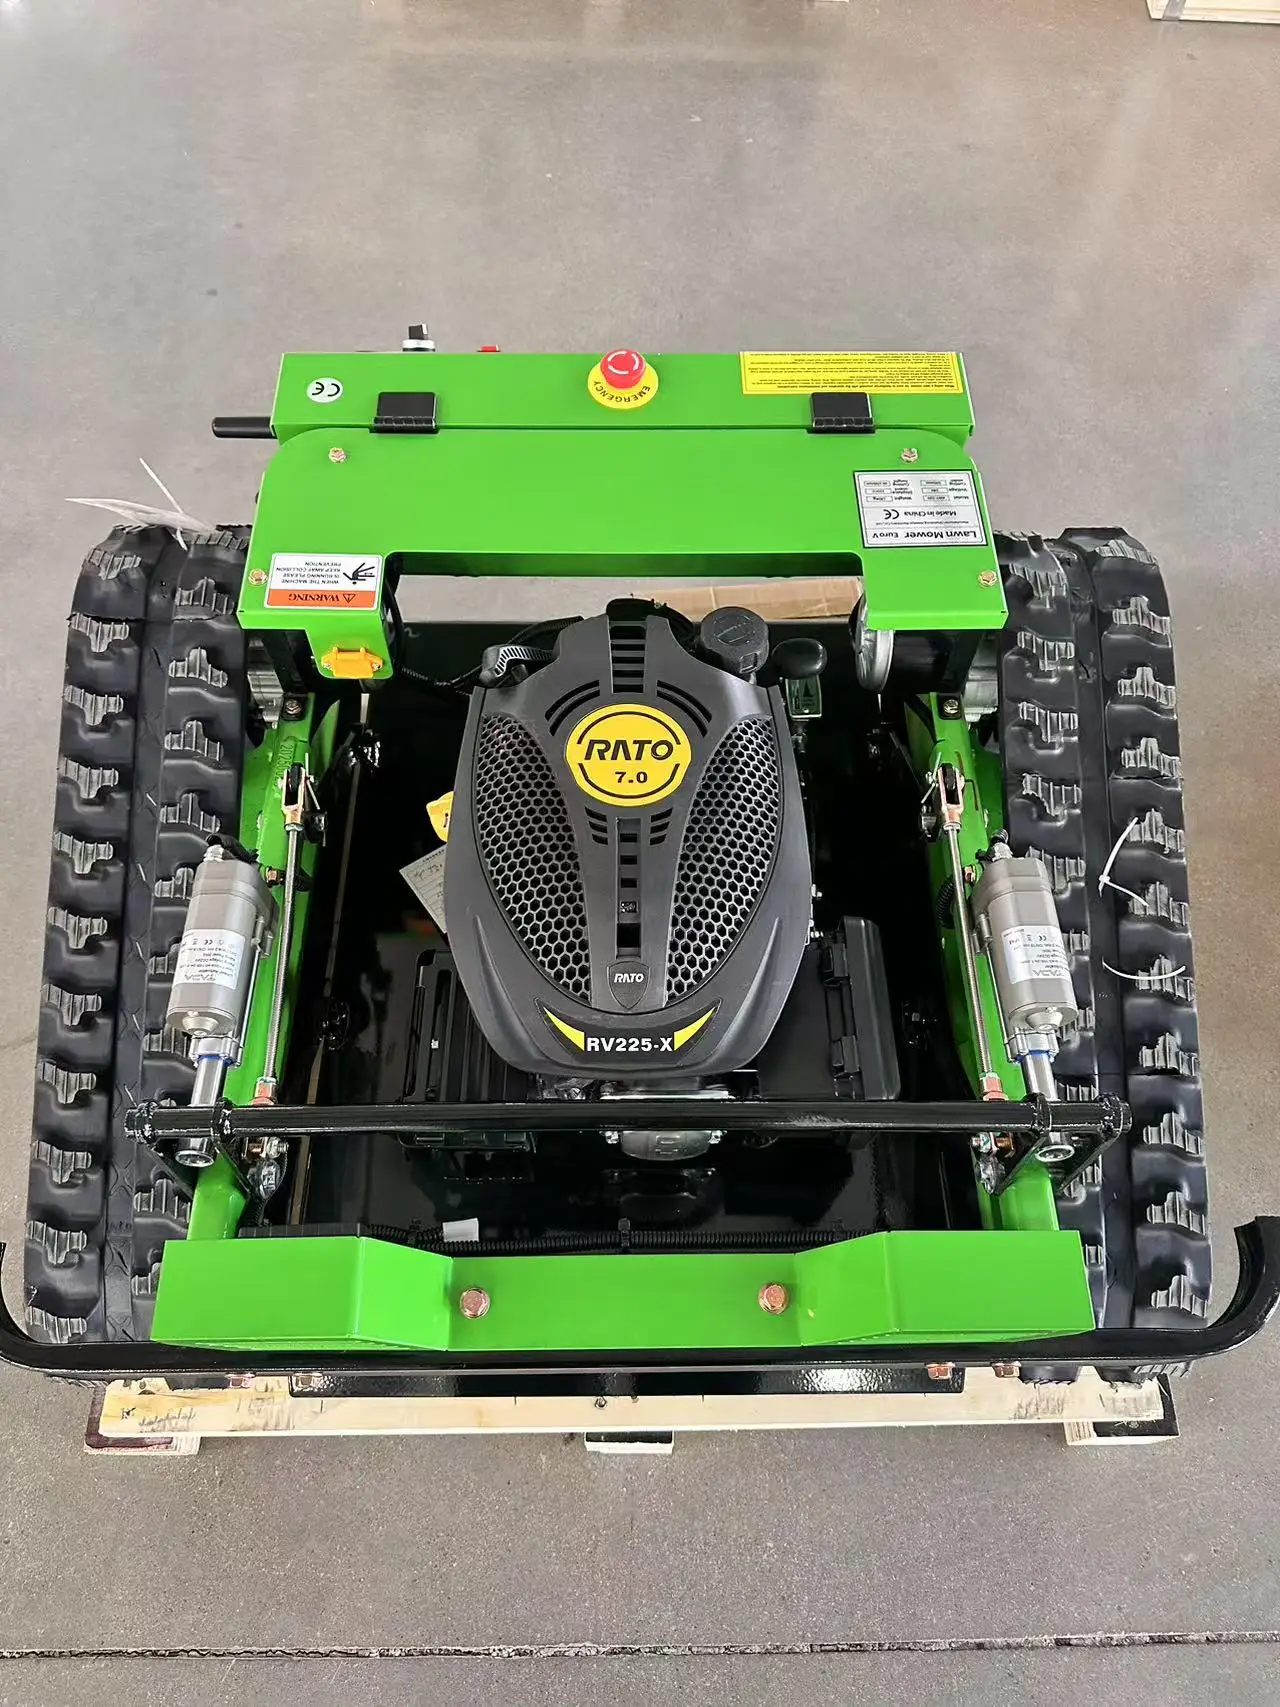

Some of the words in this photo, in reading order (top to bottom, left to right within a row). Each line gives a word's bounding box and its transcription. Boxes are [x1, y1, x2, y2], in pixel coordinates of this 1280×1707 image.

[593, 380, 651, 403] EMERGENCY
[904, 531, 943, 539] Mower
[945, 530, 977, 539] Lawn
[288, 593, 341, 602] WARNING
[584, 739, 674, 761] RATO
[614, 771, 648, 784] 7.0
[614, 973, 644, 984] RATO
[586, 1037, 673, 1052] RV225-X
